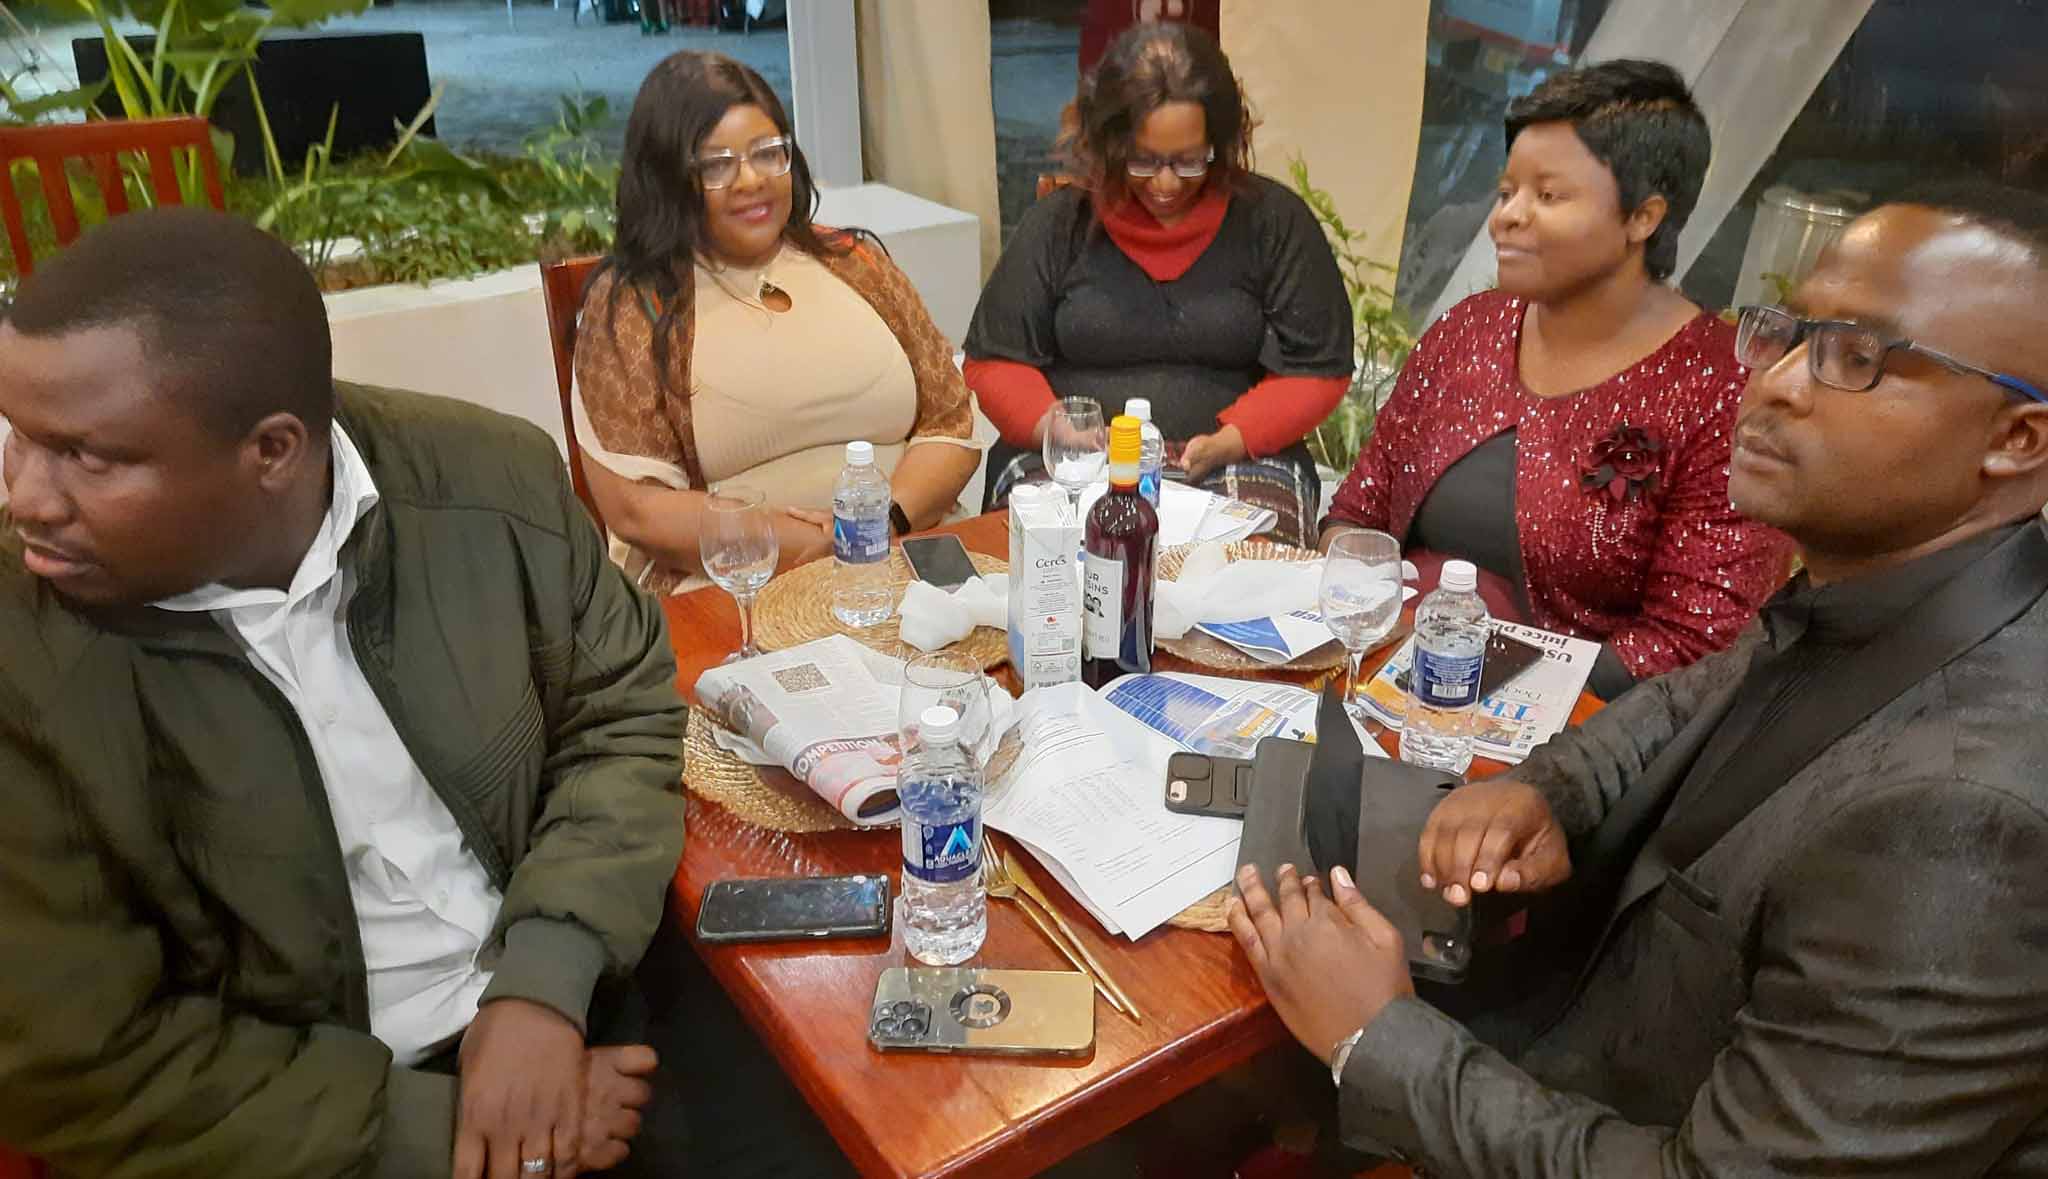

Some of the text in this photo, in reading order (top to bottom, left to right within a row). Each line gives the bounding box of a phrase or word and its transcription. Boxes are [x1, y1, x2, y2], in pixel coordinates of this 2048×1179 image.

[1036, 554, 1067, 569] Ceres
[1522, 630, 1568, 649] juice
[797, 738, 880, 776] OMPETITION
